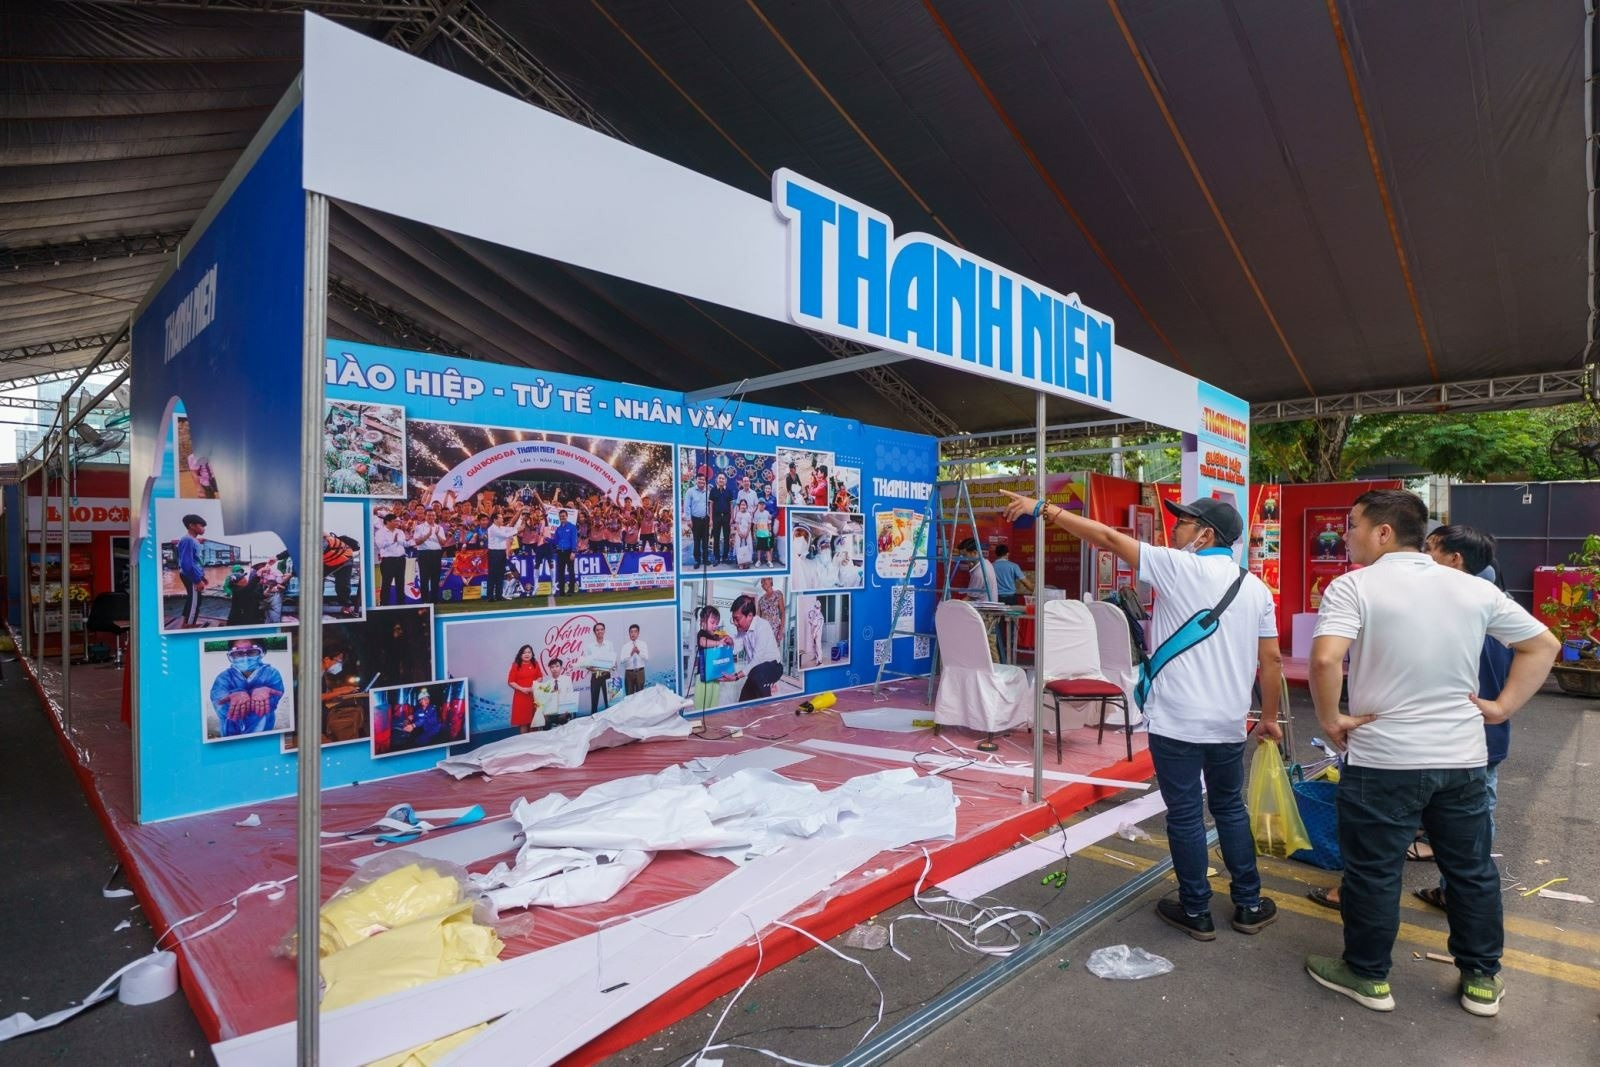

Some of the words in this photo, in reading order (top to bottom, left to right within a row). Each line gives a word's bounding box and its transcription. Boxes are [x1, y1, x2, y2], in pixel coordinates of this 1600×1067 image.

[786, 179, 1013, 374] THANH
[1021, 284, 1112, 403] NIÊN
[164, 290, 194, 365] THANH
[404, 368, 485, 405] HIỆP
[512, 378, 553, 409] TỬ
[558, 385, 595, 414] TẾ
[614, 397, 683, 425] NHÂN
[687, 405, 733, 431] VĂN
[749, 416, 780, 437] TIN
[784, 419, 818, 445] CẬY
[872, 477, 910, 499] THANH
[1374, 983, 1391, 995] PUM
[1468, 985, 1493, 999] PUMA
